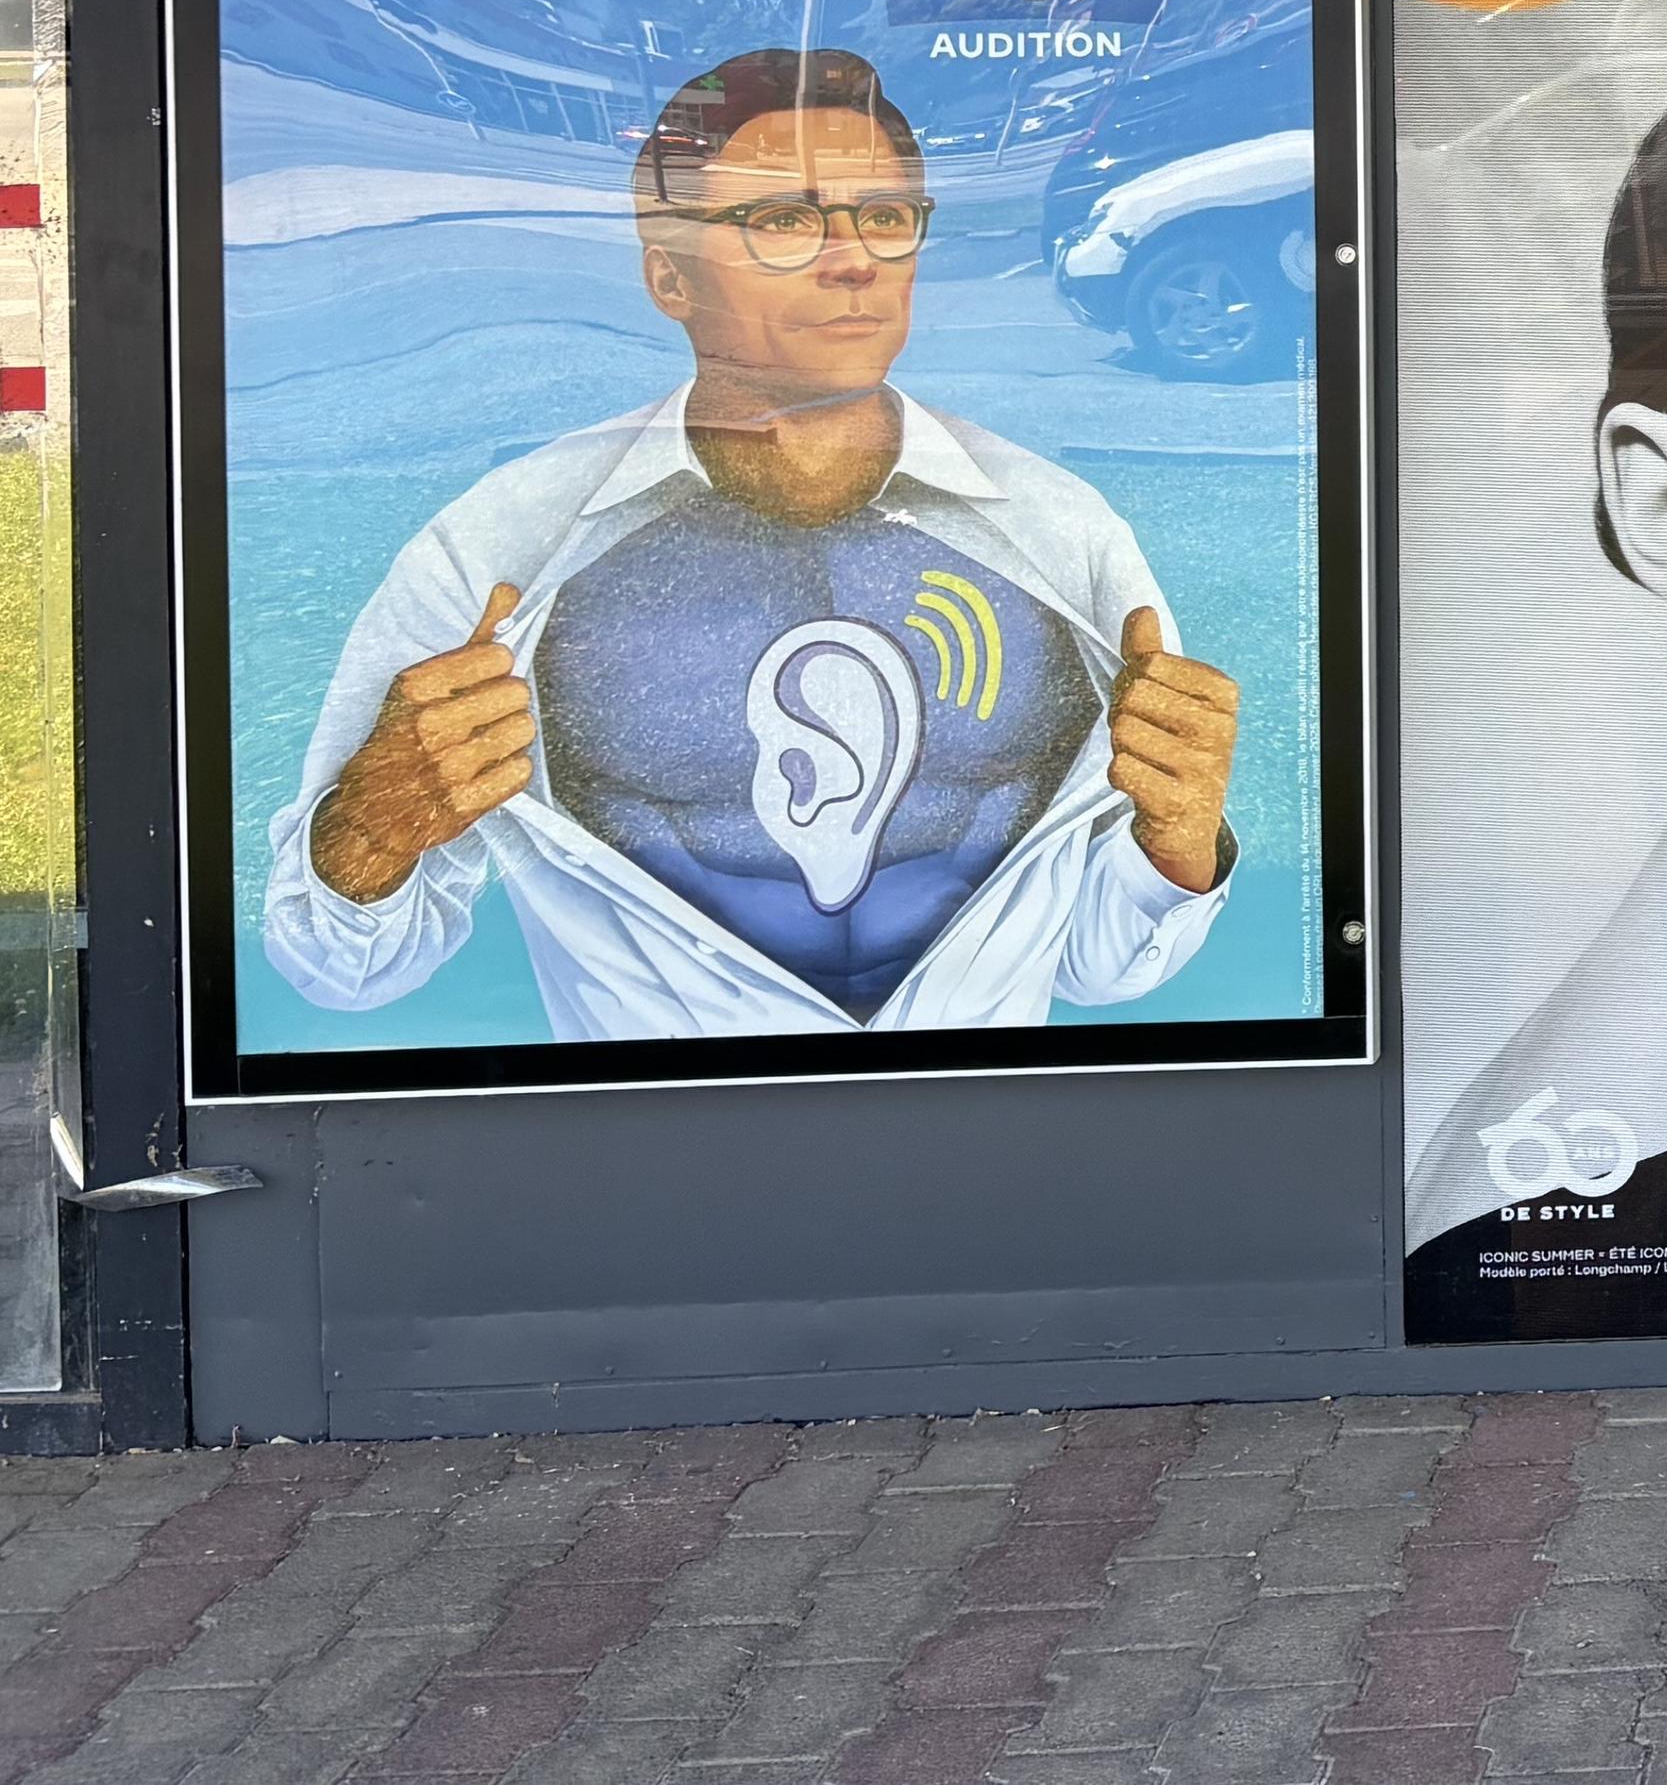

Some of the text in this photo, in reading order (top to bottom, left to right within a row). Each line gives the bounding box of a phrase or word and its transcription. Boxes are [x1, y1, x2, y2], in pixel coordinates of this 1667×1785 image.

[929, 32, 1122, 59] AUDITION
[1300, 788, 1309, 840] novembre
[1301, 843, 1309, 854] 14
[1301, 858, 1310, 872] du
[1301, 925, 1312, 1005] Conformément
[1500, 1204, 1615, 1222] DE STYLE
[1479, 1251, 1529, 1264] ICONIC
[1531, 1249, 1595, 1262] SUMMER
[1609, 1246, 1637, 1260] ÉTÉ
[1479, 1266, 1527, 1279] Modèle
[1529, 1265, 1565, 1279] porté
[1574, 1263, 1653, 1277] Longchamp
